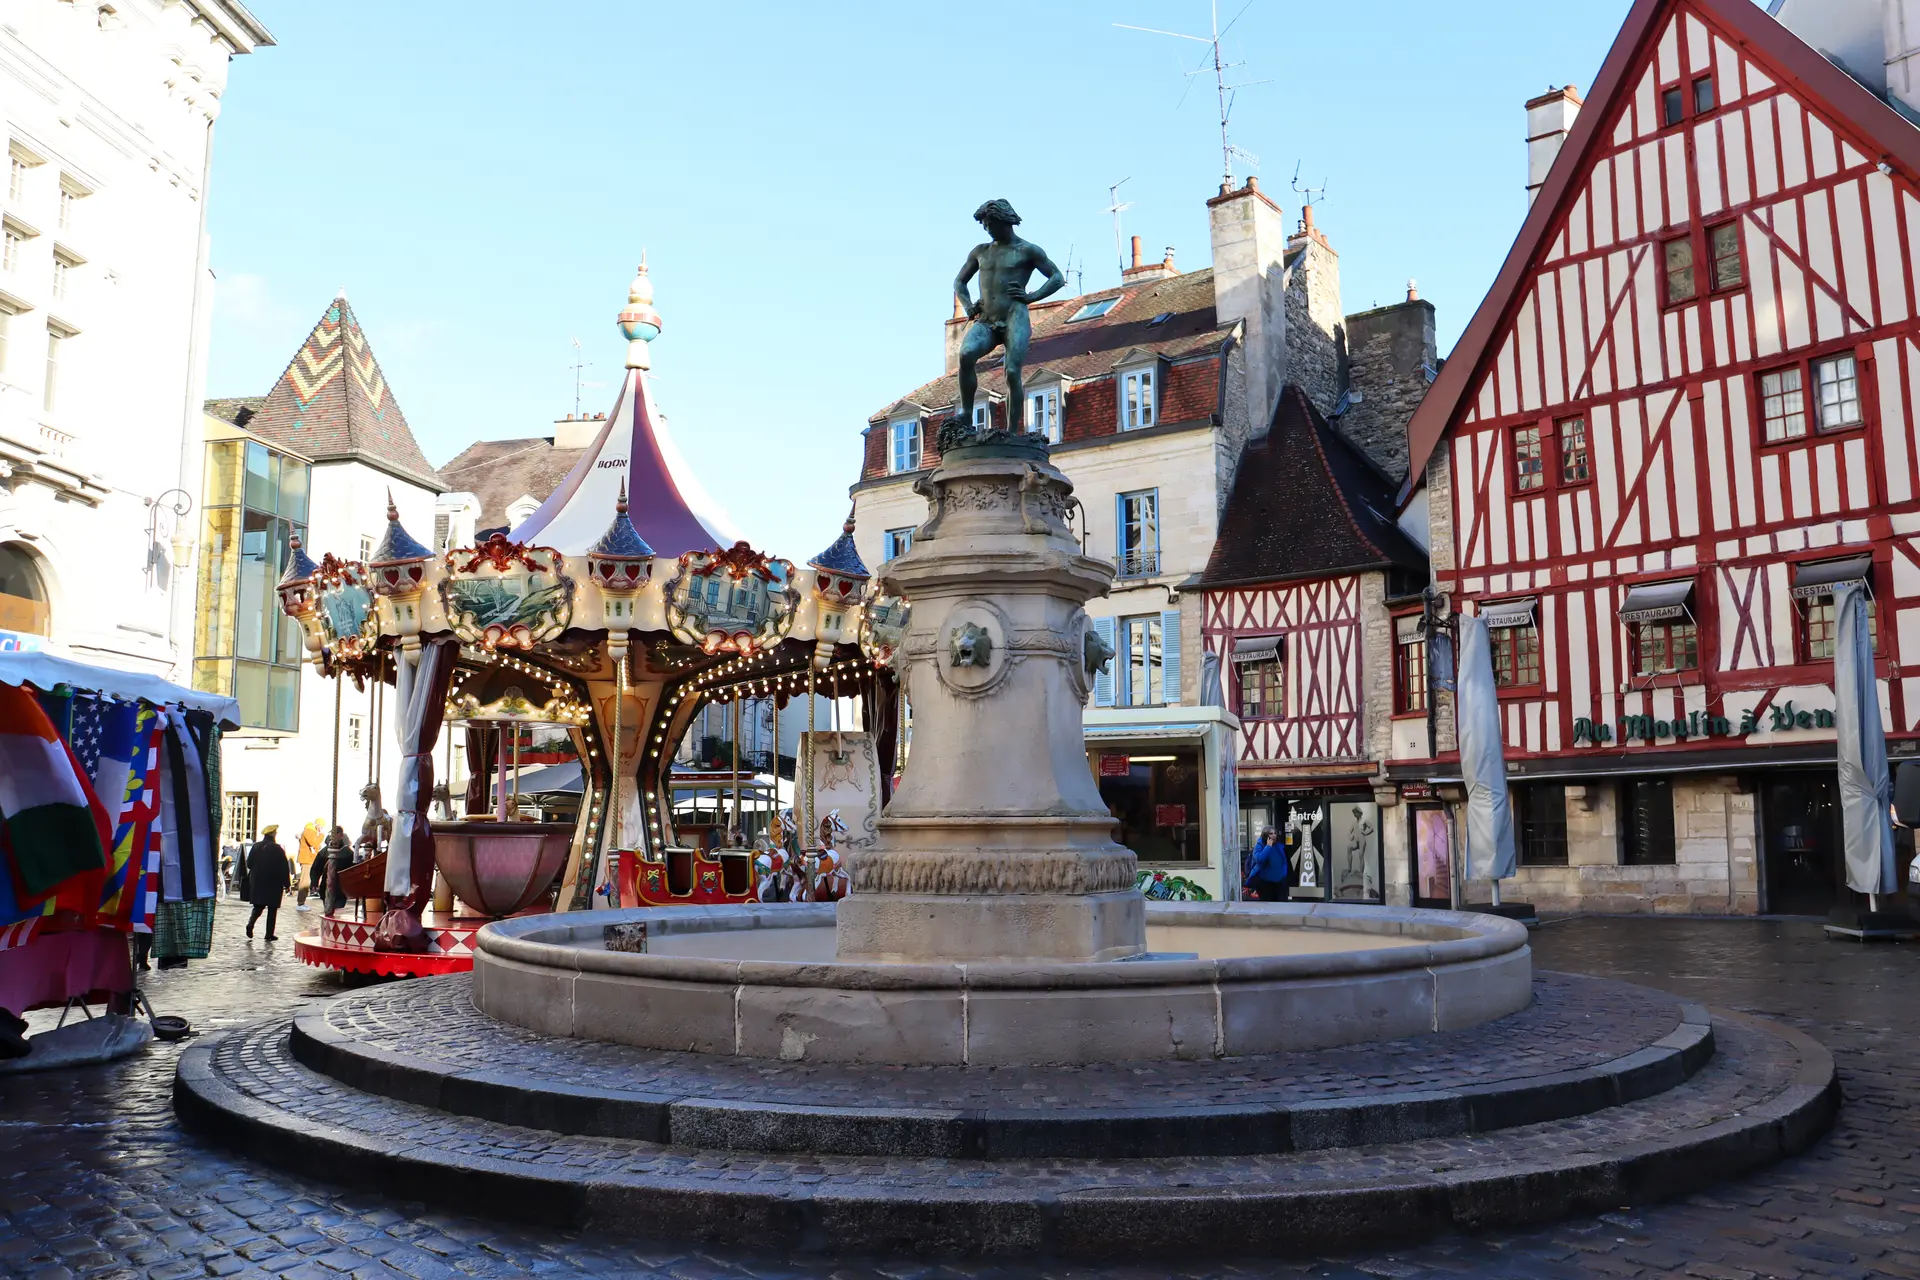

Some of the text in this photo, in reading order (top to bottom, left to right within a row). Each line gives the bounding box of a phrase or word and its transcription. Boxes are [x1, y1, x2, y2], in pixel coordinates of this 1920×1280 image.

[597, 459, 628, 469] BOON
[1625, 607, 1677, 620] RESTAURANT
[1488, 615, 1525, 626] ESTAURANT
[1234, 650, 1275, 660] RESTAURANT
[1573, 700, 1836, 743] Au Moulin à Ven
[1289, 810, 1323, 821] Entrée
